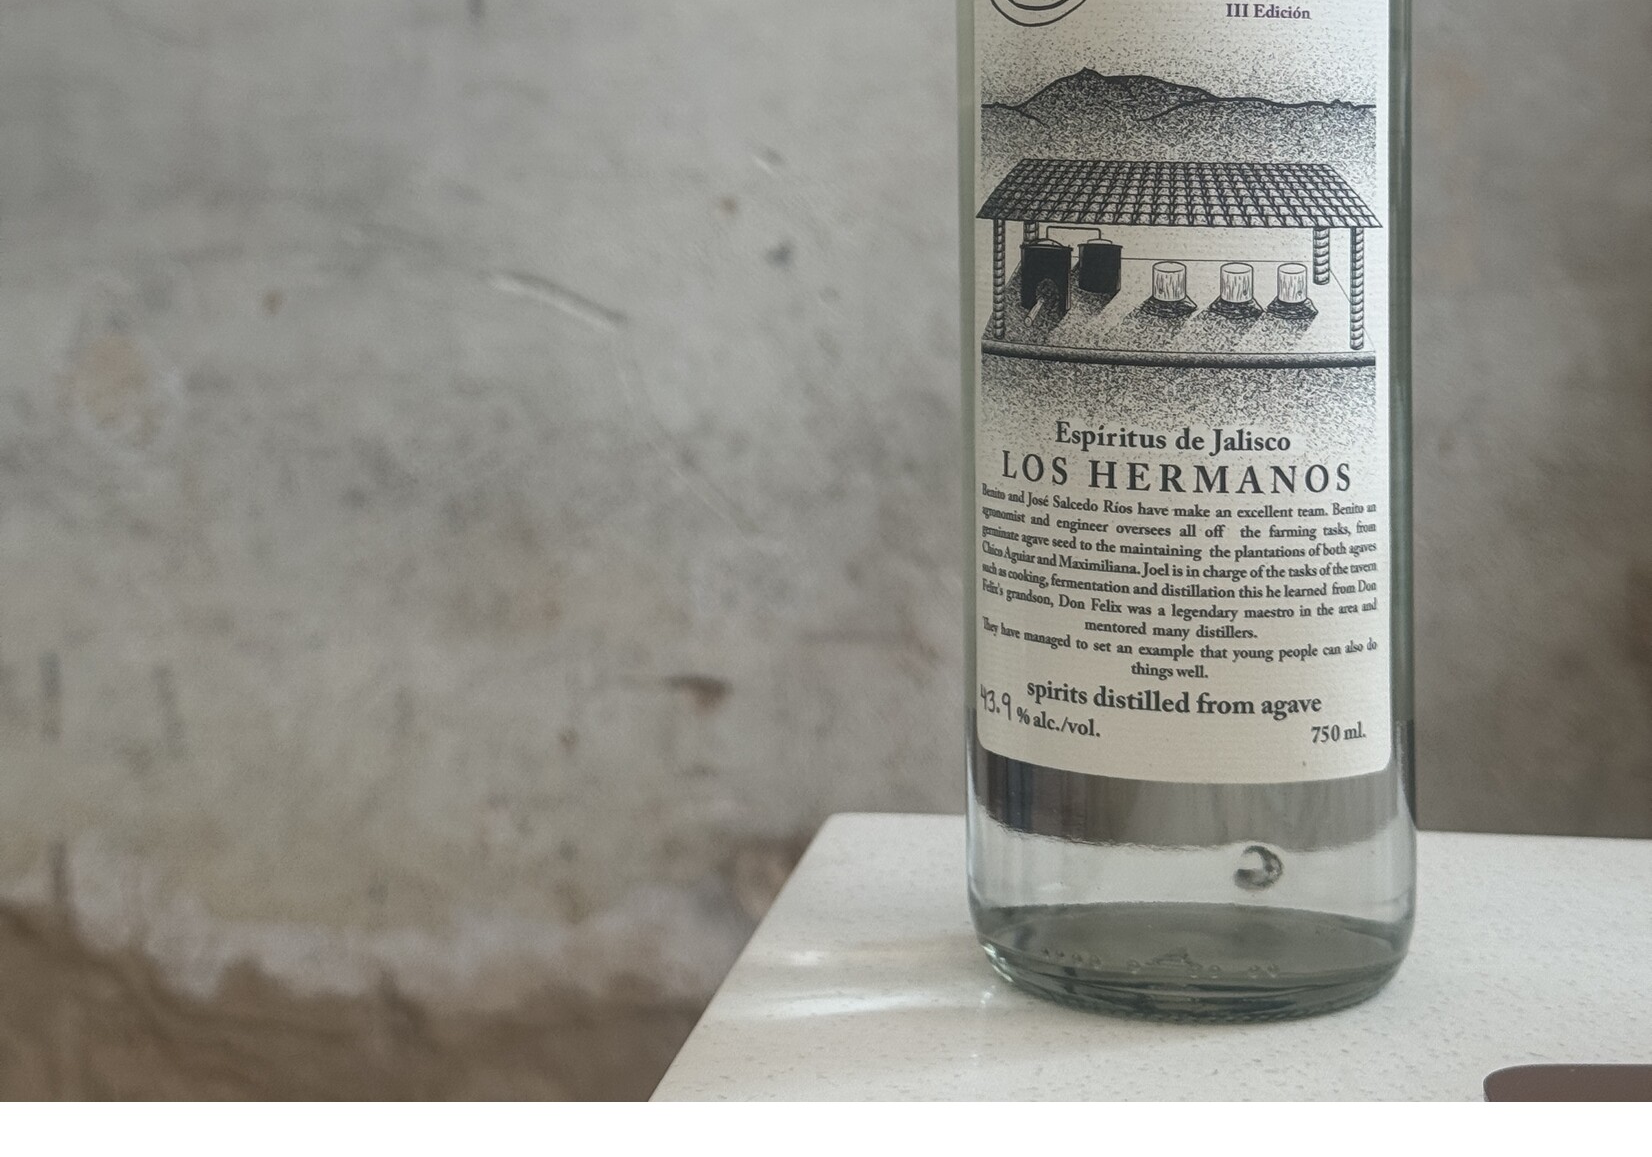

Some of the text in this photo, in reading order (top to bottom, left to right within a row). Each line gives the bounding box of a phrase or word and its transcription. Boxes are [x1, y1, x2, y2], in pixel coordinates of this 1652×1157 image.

[1226, 3, 1311, 20] III Edición
[1055, 421, 1291, 456] Espíritus de Jalisco
[1002, 450, 1351, 495] LOS HERMANOS
[981, 482, 1006, 500] Benito
[1007, 490, 1025, 504] and
[1026, 491, 1049, 508] José
[1052, 494, 1098, 512] Salcedo
[1136, 502, 1169, 516] have
[1173, 504, 1210, 518] make
[1215, 508, 1232, 518] an
[1236, 505, 1293, 518] excellent
[1297, 506, 1329, 517] team.
[1331, 502, 1364, 515] Benito
[1366, 503, 1377, 513] an
[981, 525, 1377, 562] germinate agave seed to the maintaining the plantations of both agaves
[1030, 513, 1050, 527] and
[1056, 518, 1109, 533] engineer
[1116, 524, 1172, 537] oversees
[1179, 524, 1197, 537] all
[1204, 524, 1226, 538] off
[1240, 525, 1261, 538] the
[1269, 524, 1317, 541] farming
[1323, 522, 1351, 537] tasks,
[1356, 520, 1377, 534] from
[981, 540, 1377, 583] Chico Aguiar and Maximiliana. Joel is in charge of the tasks of the tavern
[981, 562, 1377, 598] such as cooking, fermentation and distillation this he learned from Don
[982, 578, 1377, 622] Felix's grandson, Don Felix was a legendary maestro in the area and
[982, 615, 1378, 663] They have managed to set an example that young people can also do
[1084, 621, 1258, 641] mentored many distillers.
[1130, 661, 1209, 681] things well.
[1027, 680, 1322, 721] spirits distilled from agave
[1033, 711, 1101, 738] alc./vol.
[1311, 720, 1367, 743] 750 ml.
